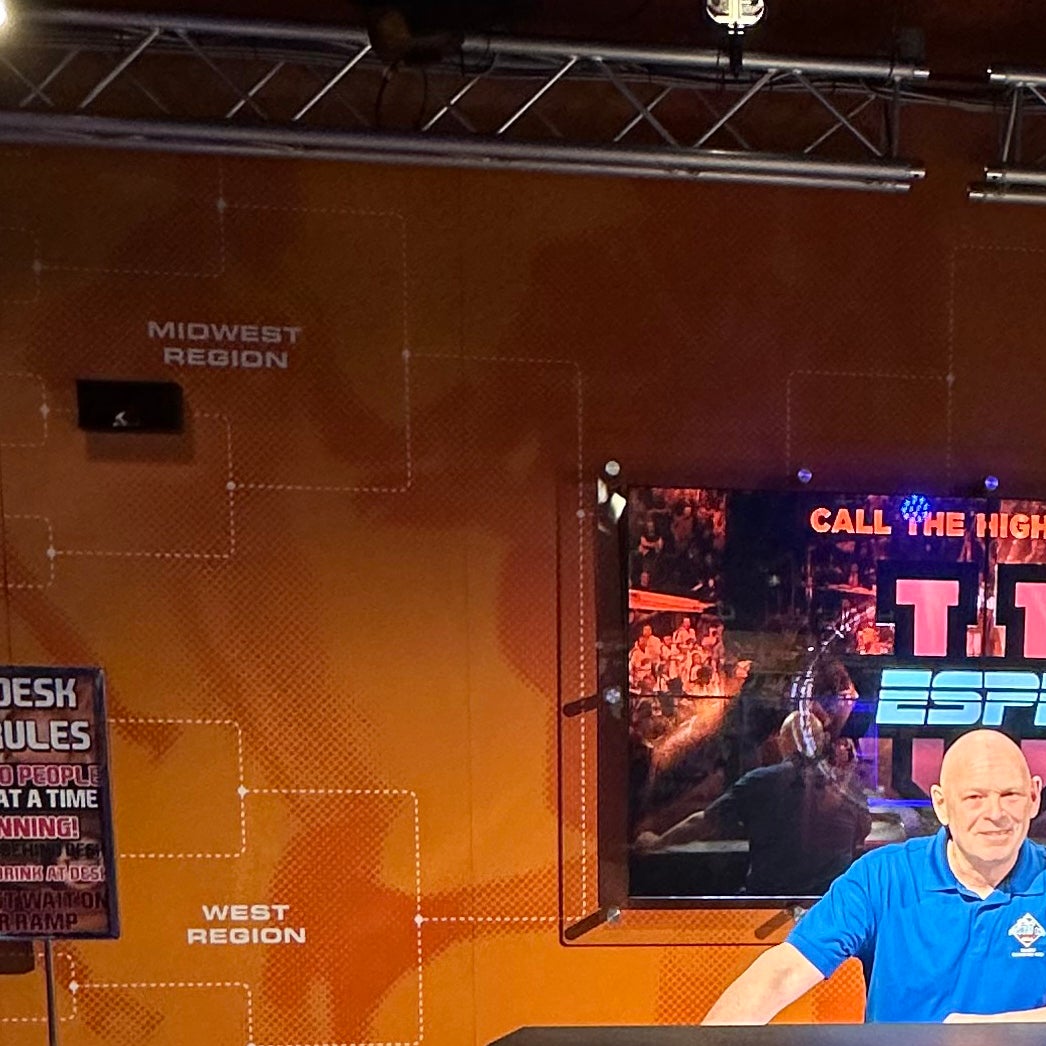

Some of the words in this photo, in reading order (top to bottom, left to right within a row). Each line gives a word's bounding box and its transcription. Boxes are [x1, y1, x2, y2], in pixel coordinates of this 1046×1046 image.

[148, 321, 302, 344] MIDWEST
[163, 347, 288, 368] REGION
[810, 507, 891, 535] CALL
[905, 510, 965, 537] THE
[0, 720, 91, 750] ULES
[17, 765, 99, 787] PEOPLE
[27, 789, 42, 808] A
[46, 789, 98, 808] TIME
[0, 865, 43, 881] RINK
[46, 865, 65, 881] AT
[21, 891, 75, 909] WAIT
[16, 912, 78, 930] RAMP
[202, 905, 290, 921] WEST
[187, 928, 306, 944] REGION
